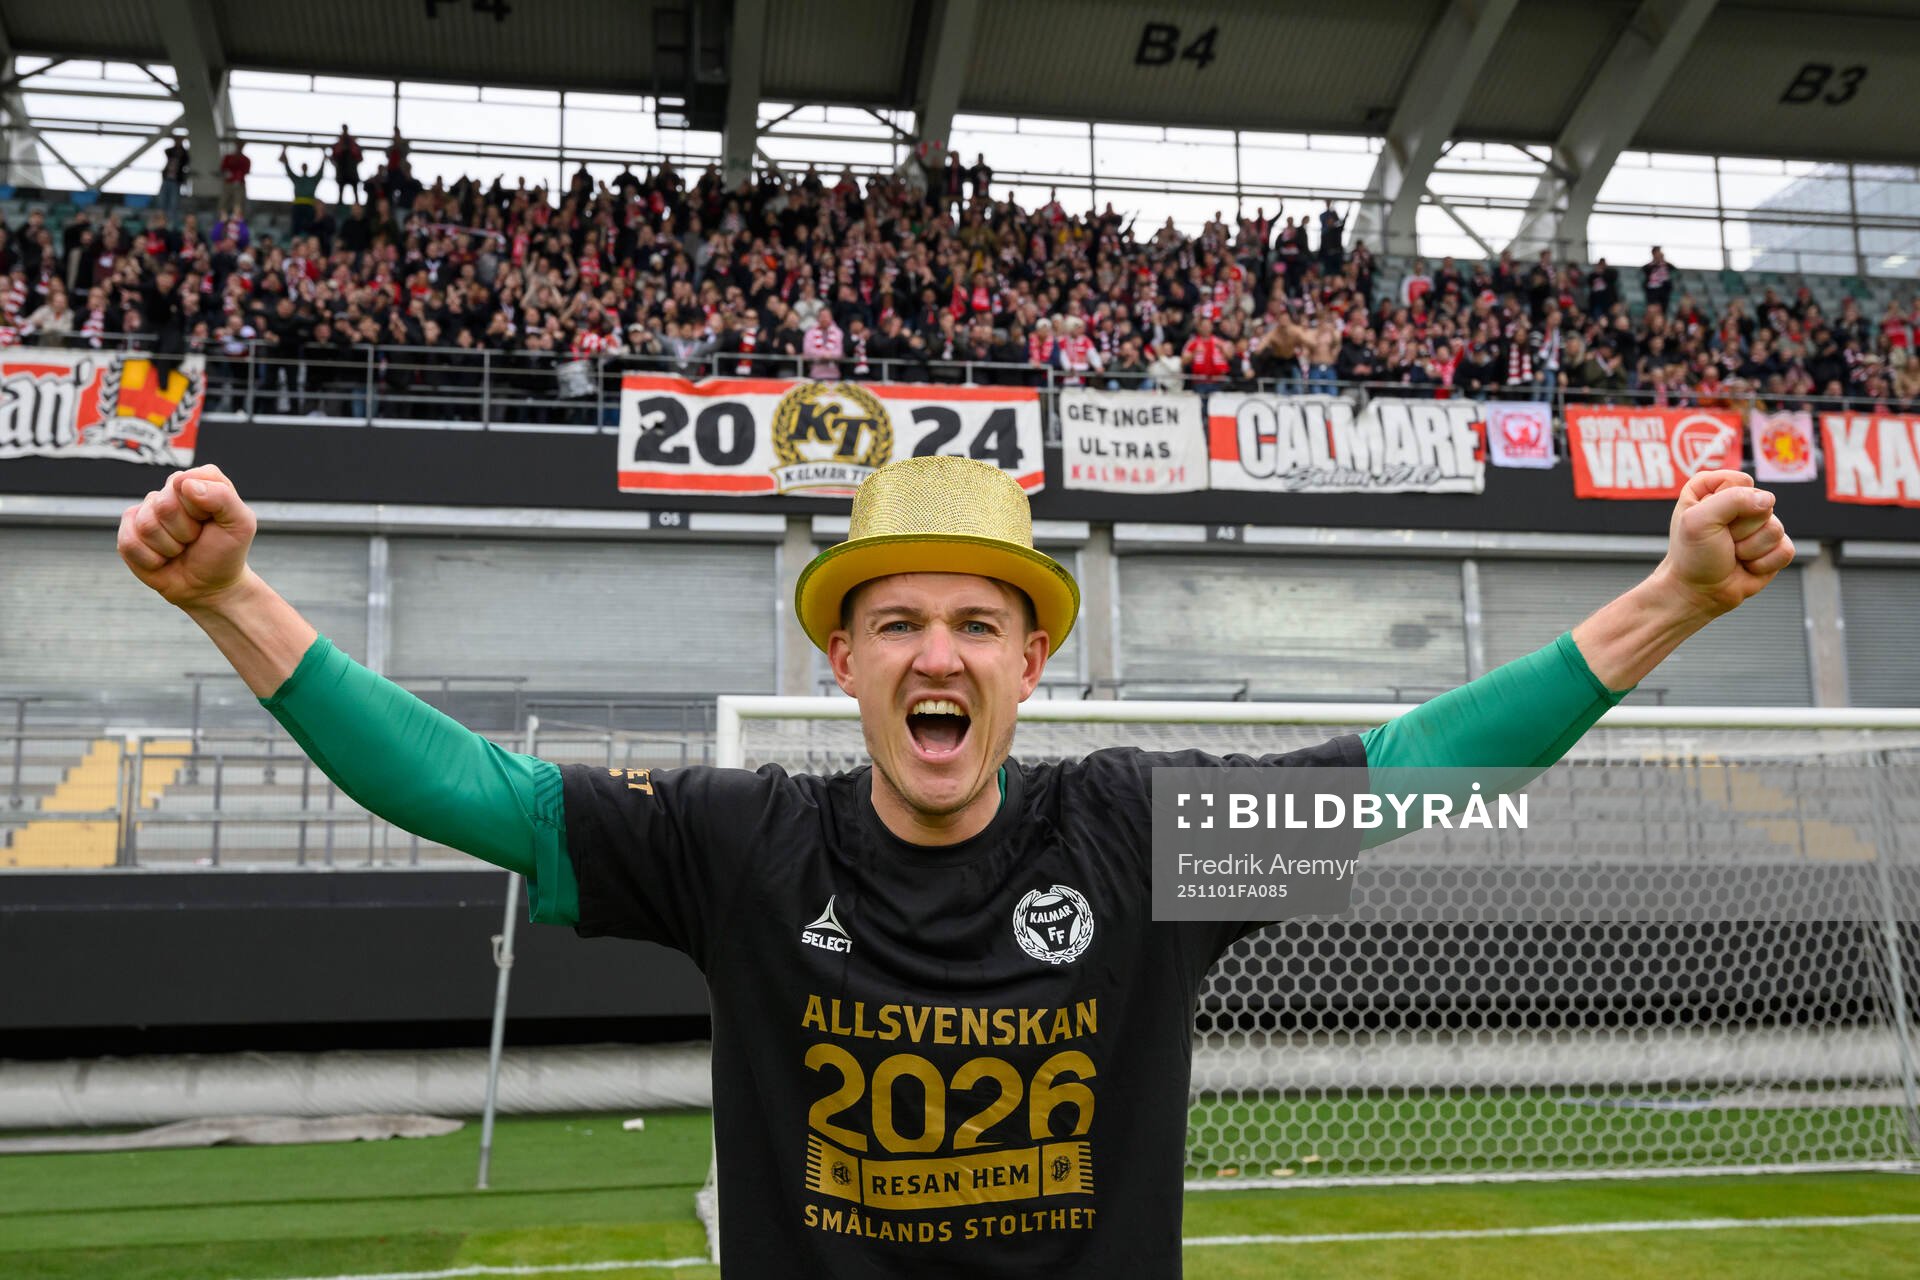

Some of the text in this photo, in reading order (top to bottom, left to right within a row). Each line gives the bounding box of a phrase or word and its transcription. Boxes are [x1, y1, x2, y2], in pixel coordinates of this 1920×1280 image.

[1134, 22, 1218, 69] B4
[1778, 64, 1868, 106] B3
[634, 397, 1025, 470] 20 KT 24
[1068, 404, 1180, 427] GETINGEN
[1079, 437, 1171, 460] ULTRAS
[1237, 398, 1485, 480] CALMARE
[1826, 415, 1920, 502] KA
[1581, 440, 1676, 489] VAR
[1029, 904, 1074, 924] KALMAR
[801, 930, 853, 954] SELECT
[1047, 926, 1065, 945] FF
[801, 994, 1098, 1046] ALLSVENSKAN
[804, 1042, 1098, 1154] 2026
[871, 1170, 962, 1197] RESAN
[972, 1163, 1031, 1190] HEM
[803, 1202, 1098, 1244] SMÅLANDS STOLTHET
